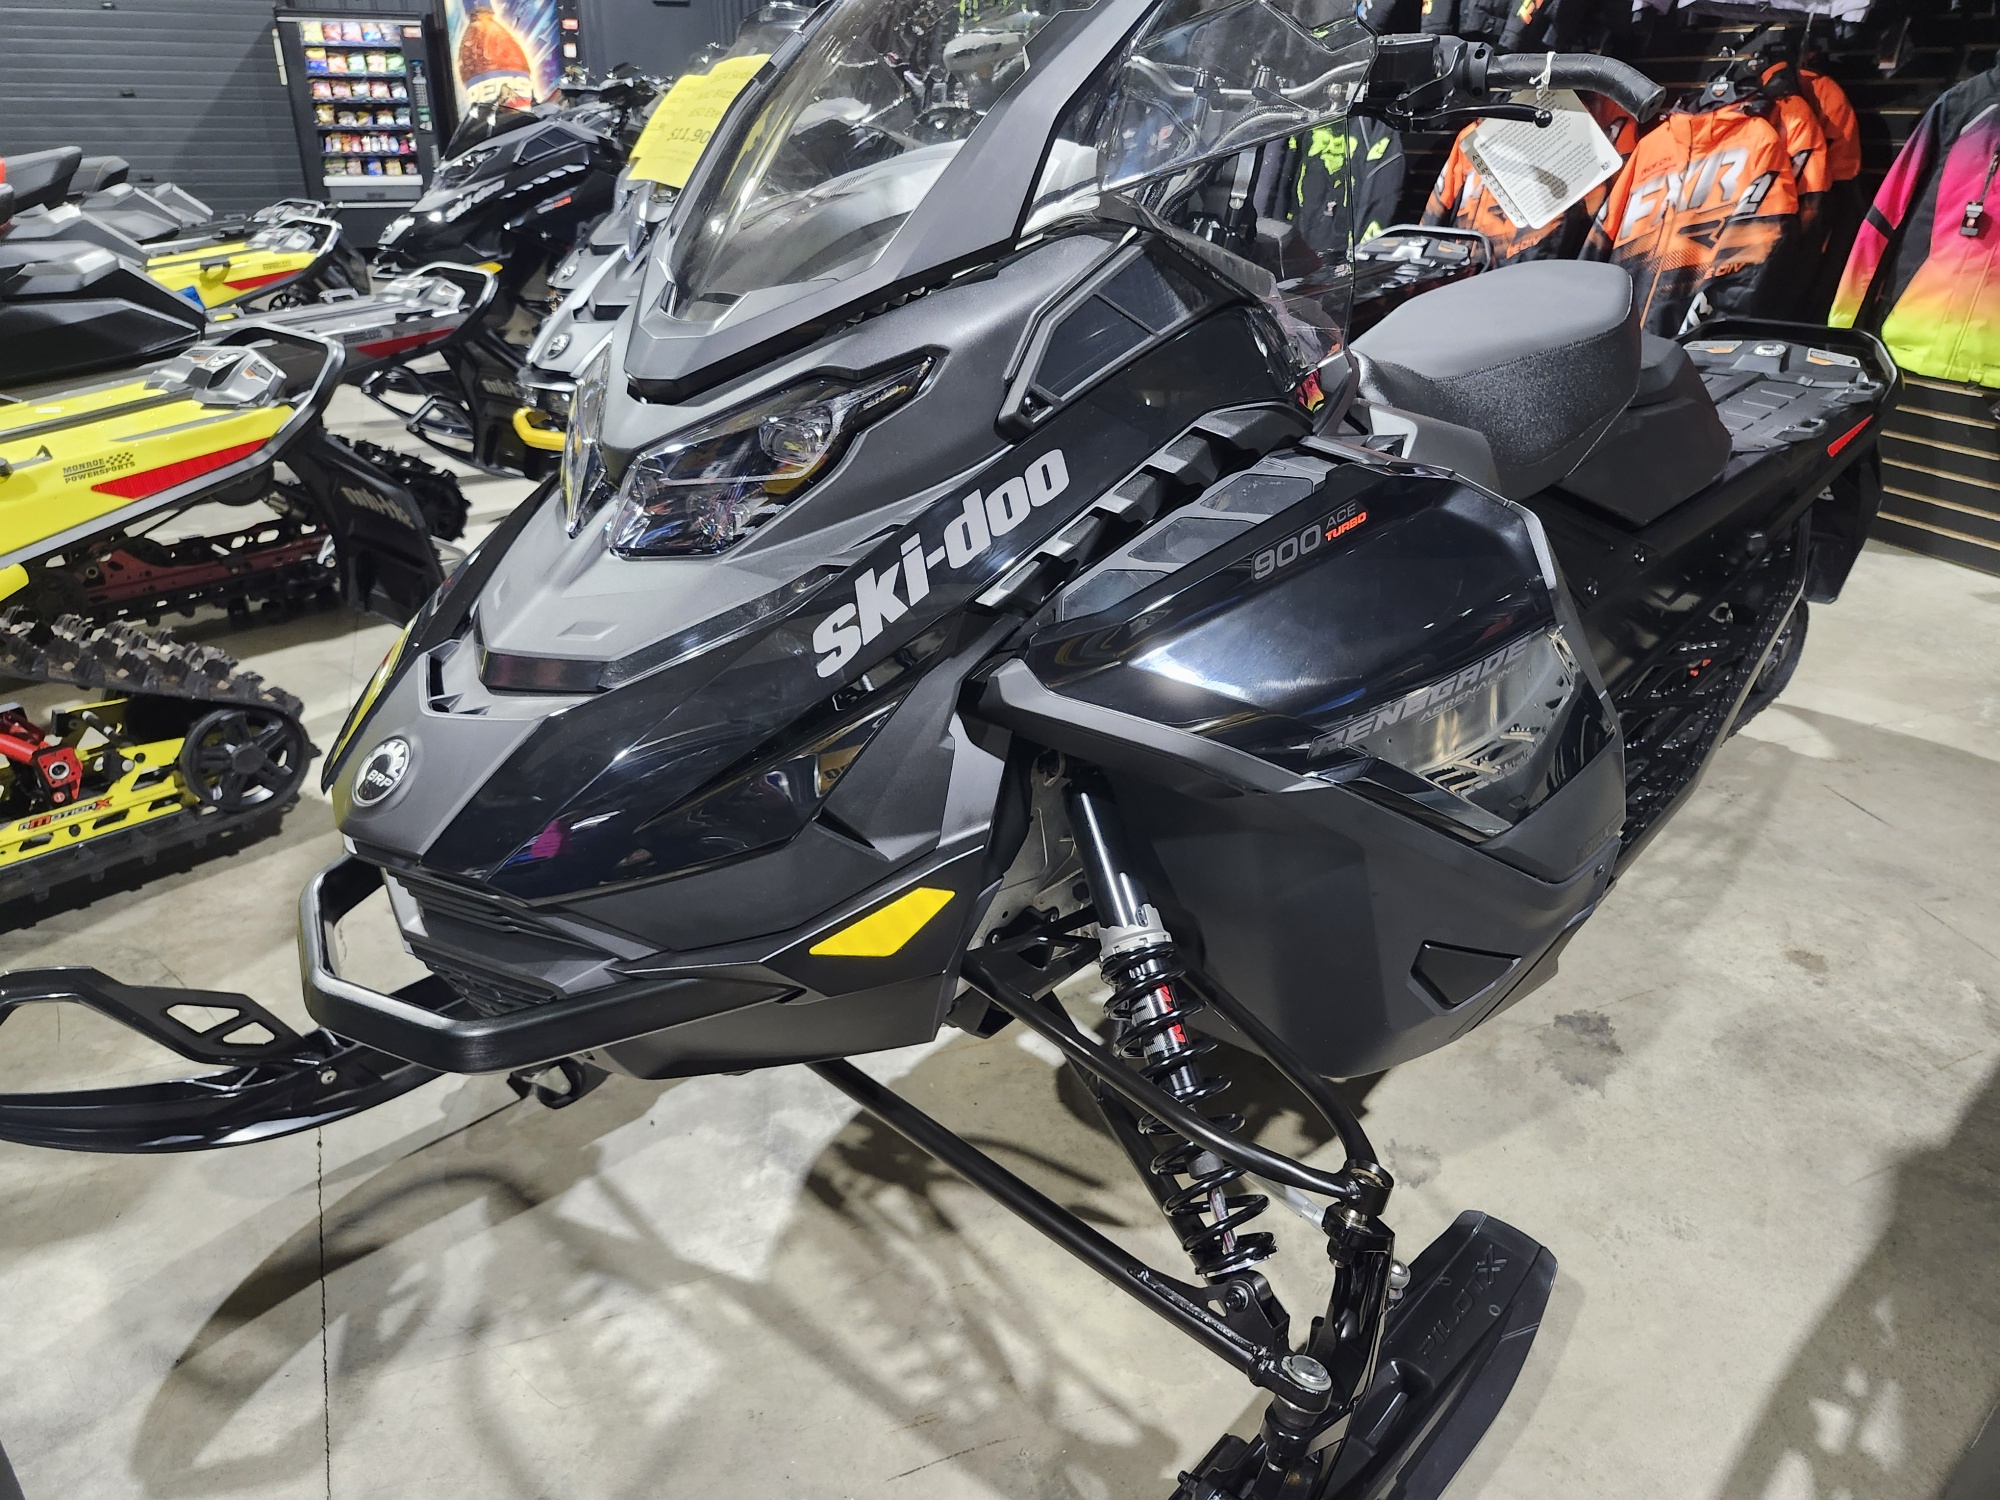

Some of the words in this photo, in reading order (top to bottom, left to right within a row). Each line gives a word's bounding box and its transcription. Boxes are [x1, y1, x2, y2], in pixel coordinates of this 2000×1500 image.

[1618, 147, 1750, 242] FXR
[62, 458, 105, 474] MONROE
[64, 461, 136, 484] POWERSPORTS
[1324, 511, 1368, 542] TURBO
[1325, 502, 1357, 530] ACE
[812, 448, 1070, 678] ski-doo
[1254, 524, 1322, 580] 900
[1306, 635, 1531, 760] RENEGADE
[1421, 662, 1523, 720] ADRENALINE
[366, 768, 394, 788] BRP
